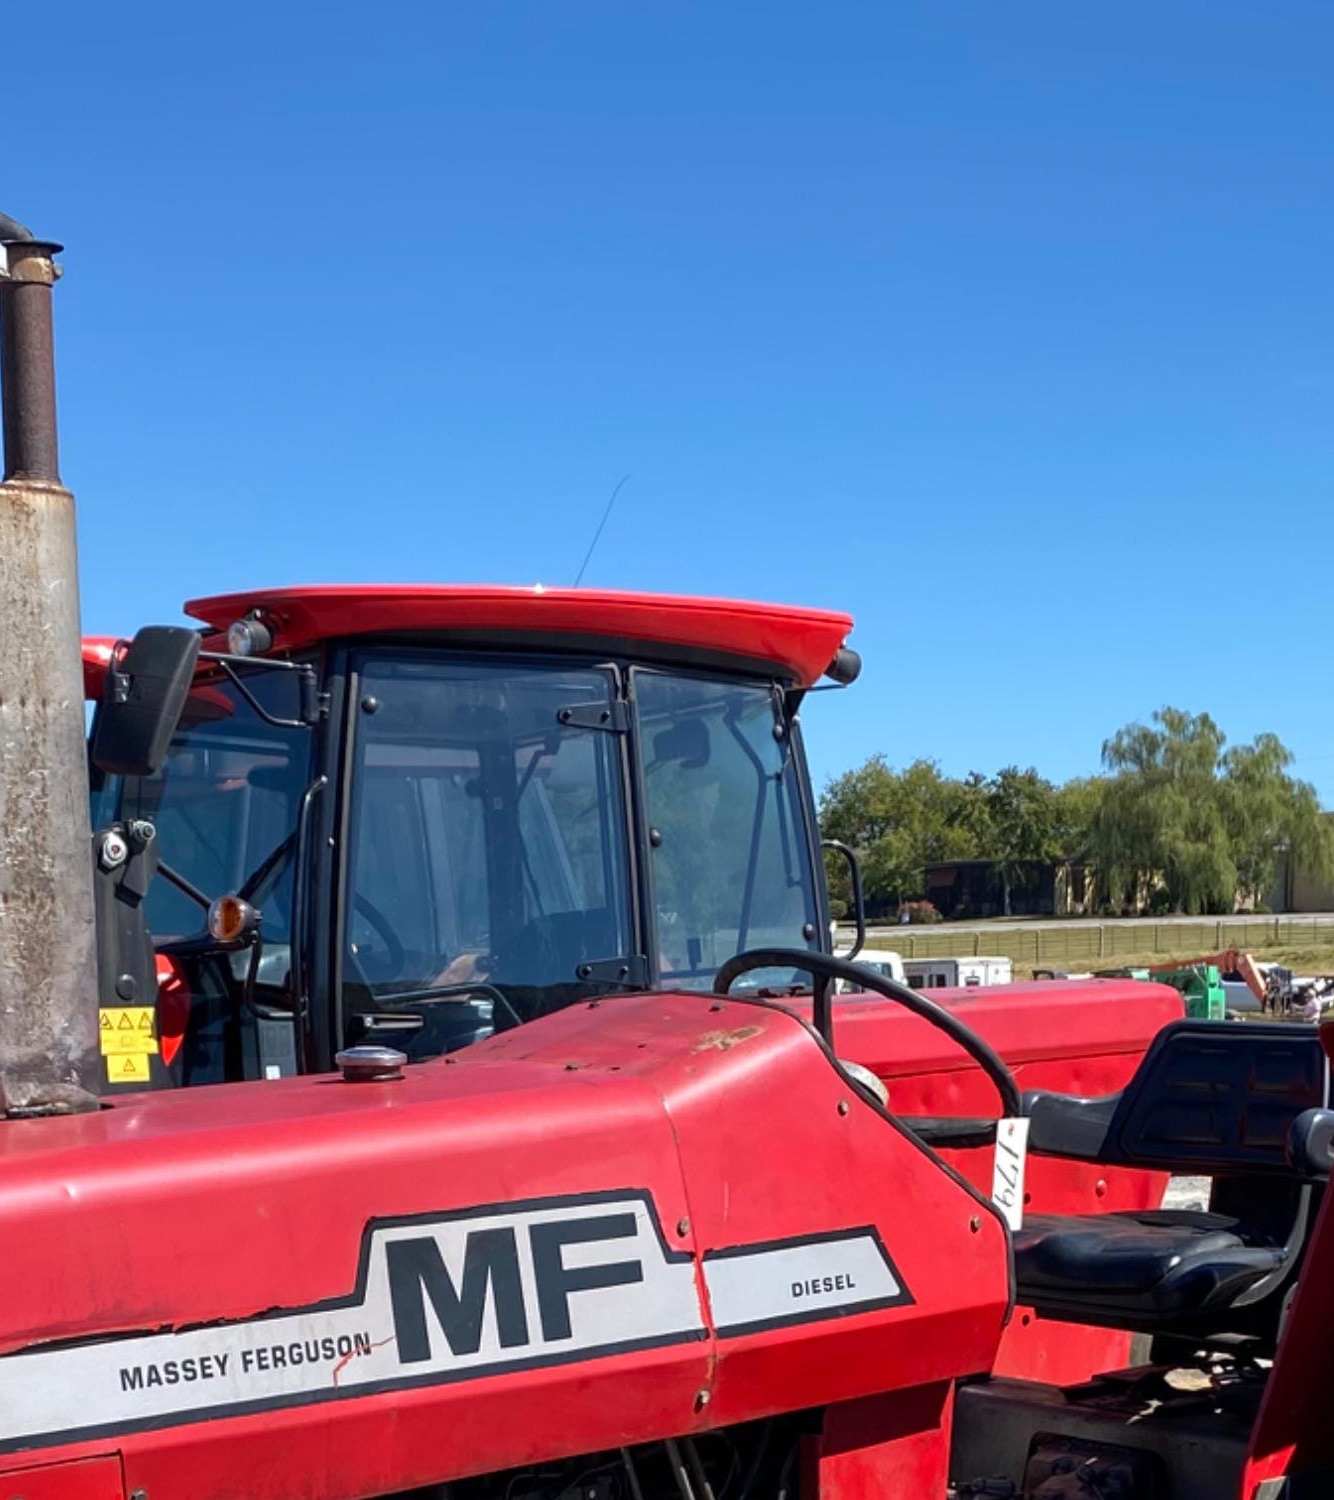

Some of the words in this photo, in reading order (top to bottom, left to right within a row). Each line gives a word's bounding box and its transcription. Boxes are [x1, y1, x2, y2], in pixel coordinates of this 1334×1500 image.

[385, 1212, 644, 1365] MF
[790, 1273, 857, 1298] DIESEL
[119, 1352, 230, 1392] MASSEY
[241, 1331, 372, 1373] FERGUSON
